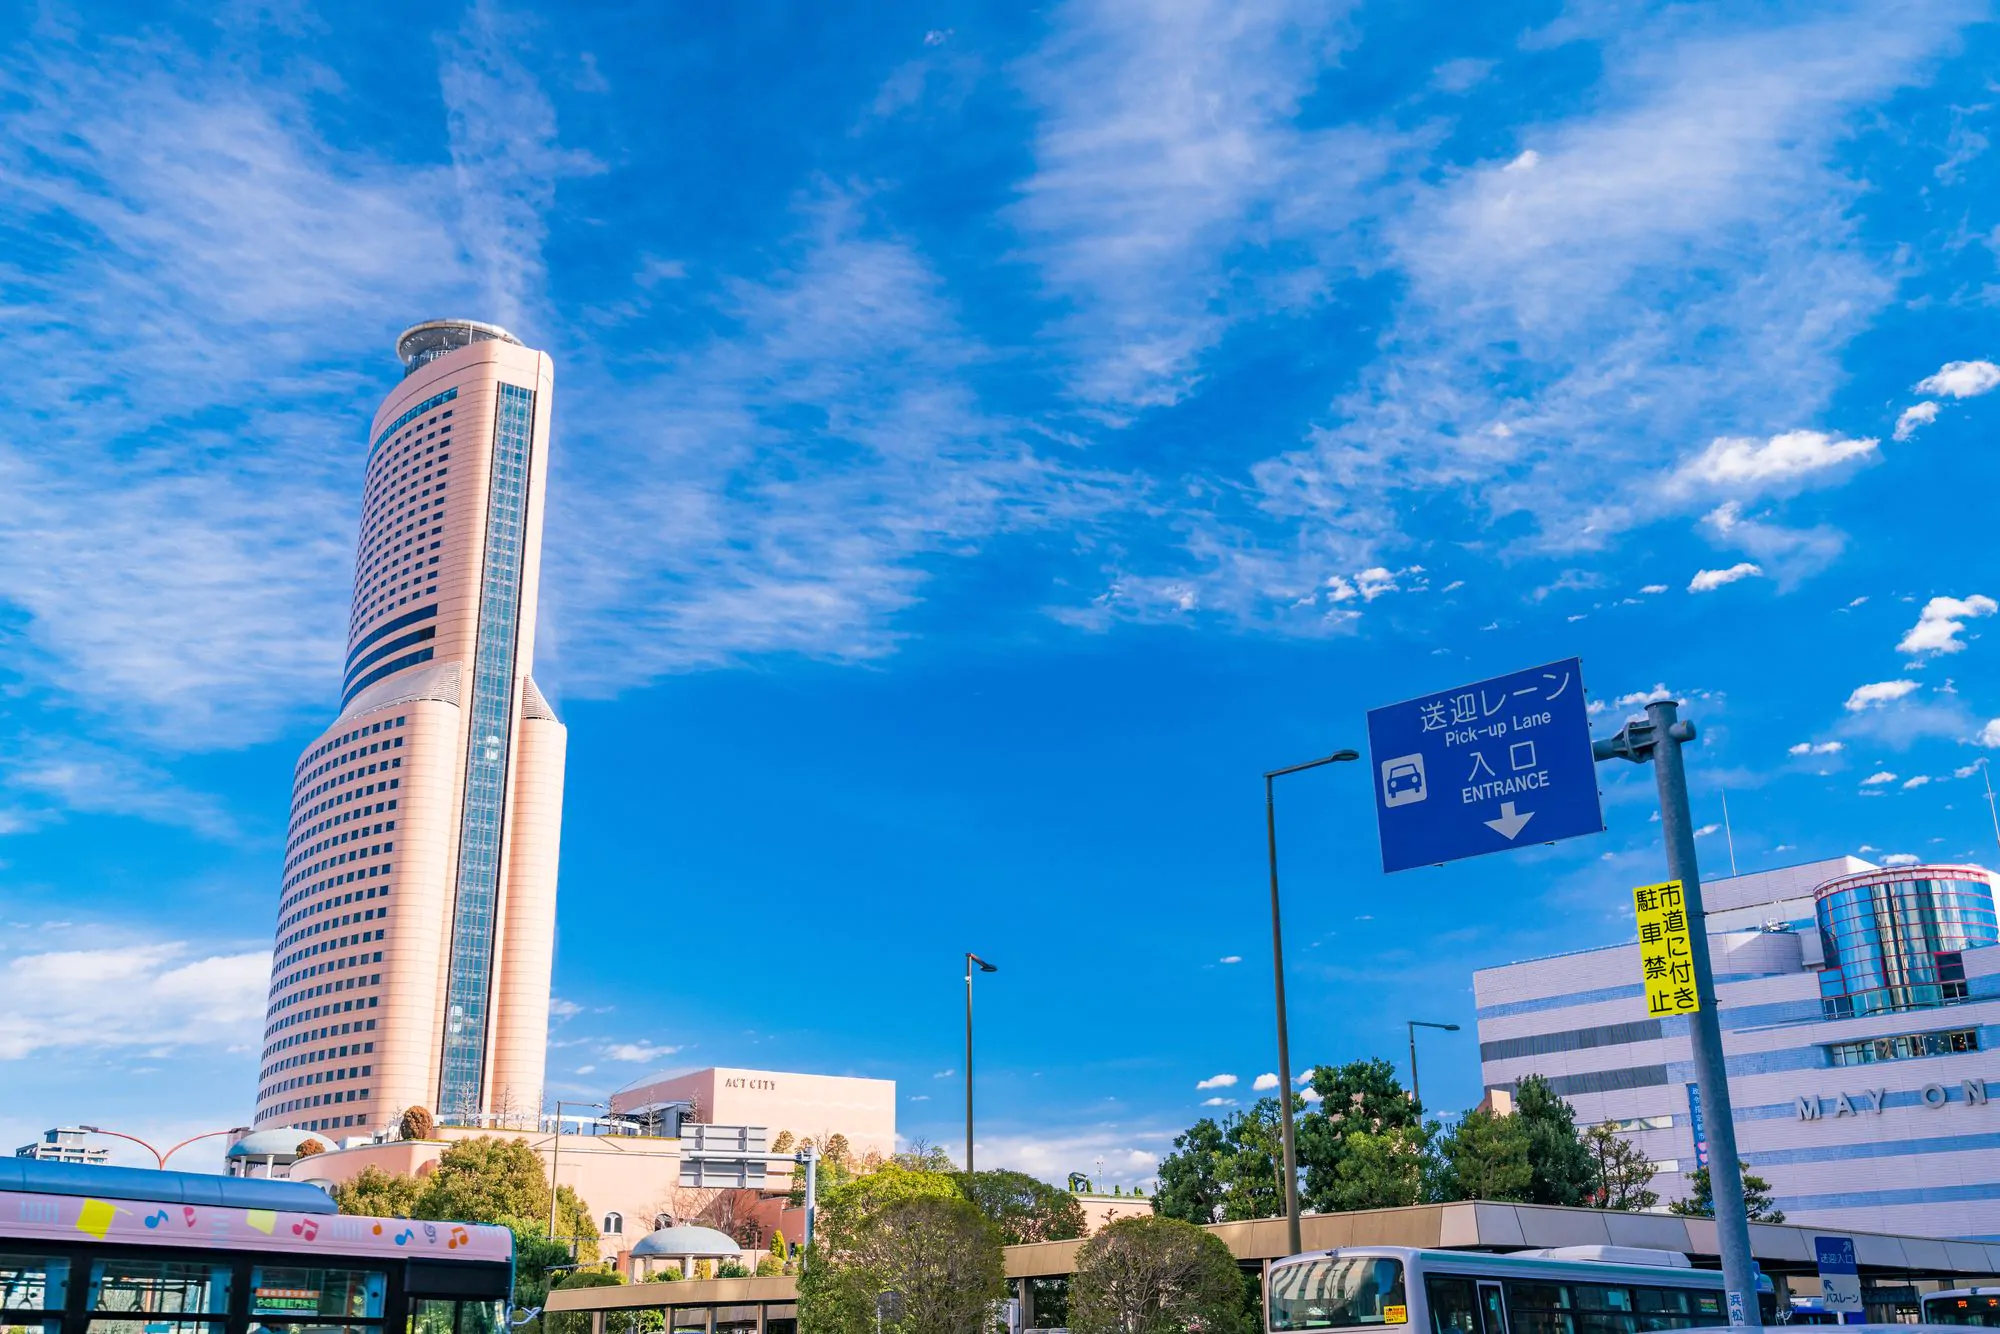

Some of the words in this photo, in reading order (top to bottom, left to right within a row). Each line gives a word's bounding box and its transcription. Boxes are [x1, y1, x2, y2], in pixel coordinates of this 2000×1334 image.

[1420, 671, 1570, 733] 送迎レーン
[1445, 721, 1507, 747] Pick-up
[1513, 711, 1551, 731] Lane
[1468, 740, 1536, 782] 入口
[1462, 770, 1550, 804] ENTRANCE
[1636, 889, 1672, 1013] 駐車禁止
[1658, 884, 1696, 1009] 市道に付き
[725, 1078, 745, 1088] ACT
[750, 1080, 775, 1090] CITY
[1796, 1087, 1886, 1122] MAY
[1826, 1293, 1859, 1304] バスレーン
